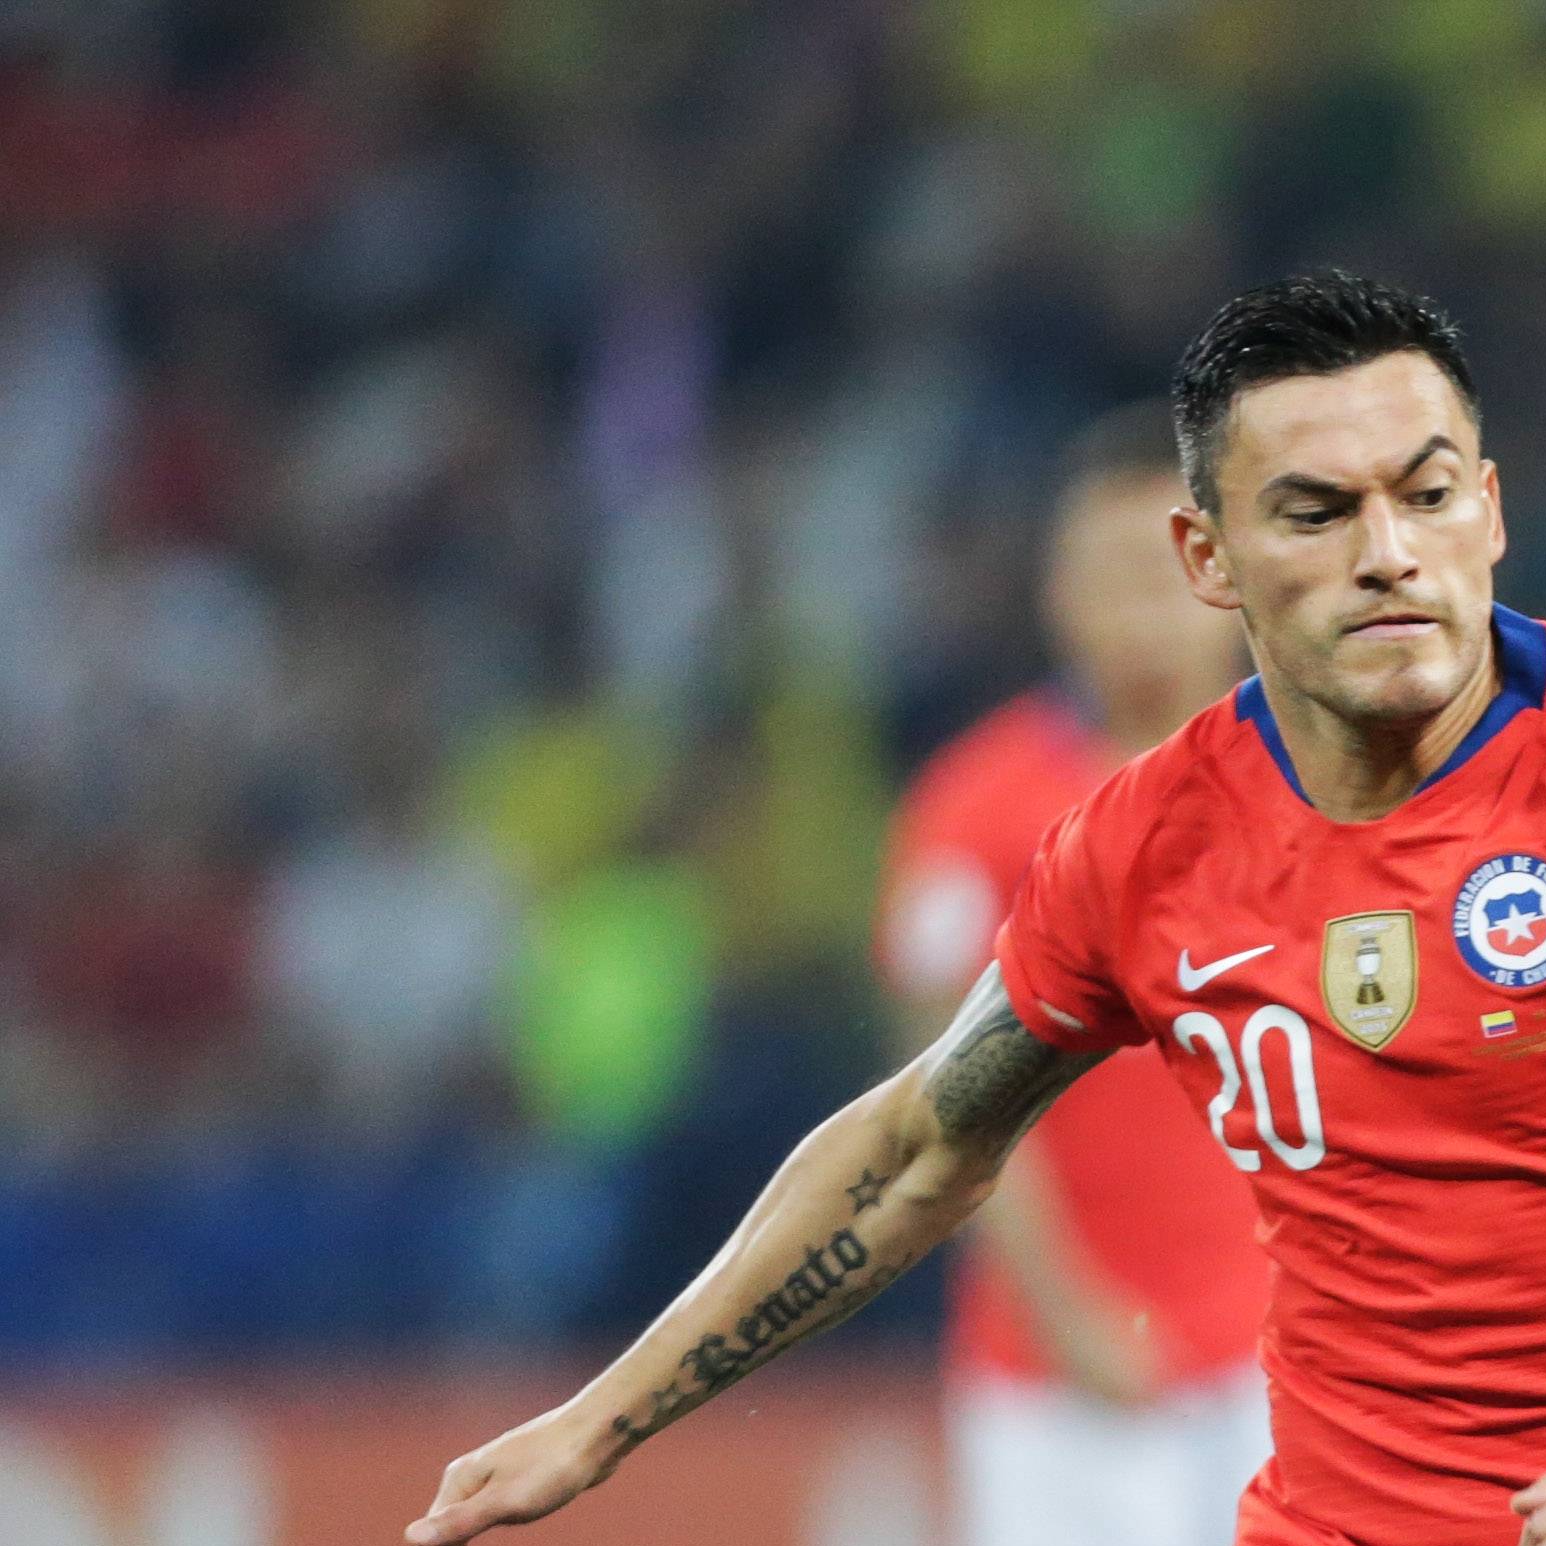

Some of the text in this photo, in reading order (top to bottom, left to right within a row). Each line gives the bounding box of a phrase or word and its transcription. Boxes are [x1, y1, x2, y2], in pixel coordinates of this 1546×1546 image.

[1512, 855, 1532, 872] DE
[1494, 969, 1516, 986] DE
[1171, 1004, 1327, 1173] 20
[678, 1226, 870, 1391] Renato
